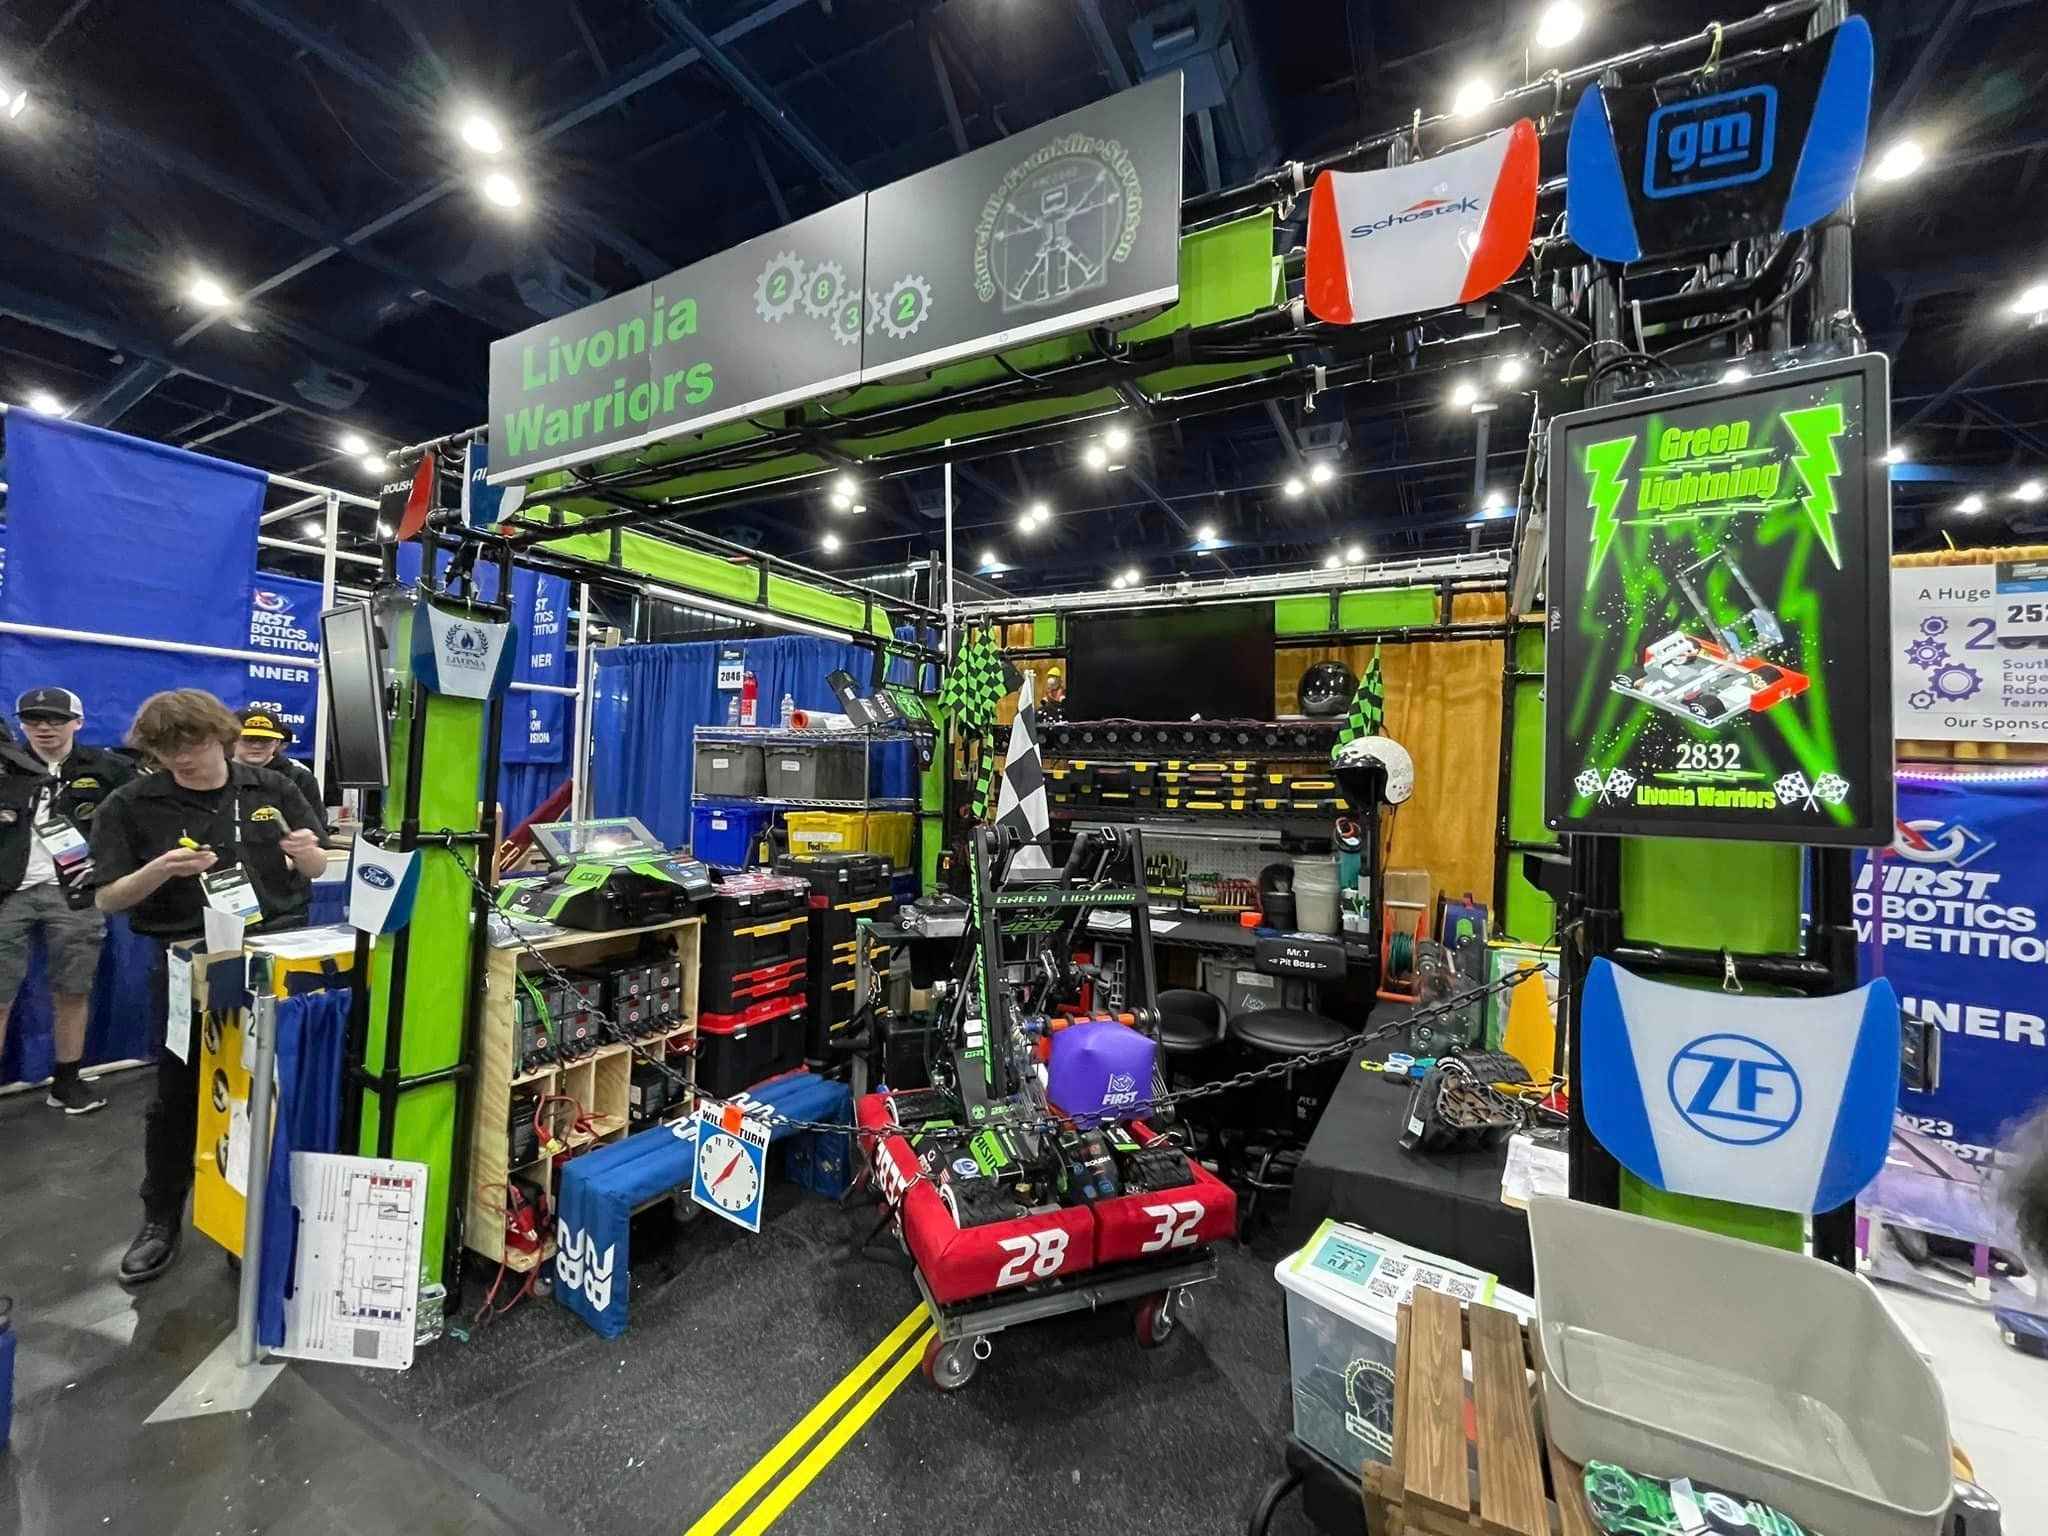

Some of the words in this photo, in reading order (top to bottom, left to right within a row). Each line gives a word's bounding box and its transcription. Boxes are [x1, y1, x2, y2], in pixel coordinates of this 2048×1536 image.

[1667, 112, 1751, 172] gm
[1349, 196, 1480, 239] Schostak
[522, 296, 698, 392] Livonia
[504, 360, 715, 457] Warriors
[1659, 420, 1750, 462] Green
[382, 480, 413, 494] ROUSH
[1637, 461, 1780, 512] Lightning
[1918, 588, 1931, 600] A
[1938, 587, 1991, 602] Huge
[252, 610, 296, 627] IRST
[250, 622, 308, 640] BOTICS
[249, 635, 319, 653] PETITION
[530, 653, 552, 669] NER
[249, 664, 309, 683] NNER
[1944, 716, 1977, 728] Our
[1675, 742, 1741, 770] 2832
[1637, 784, 1694, 807] Livonia
[1697, 786, 1776, 810] Warriors
[364, 867, 389, 886] Ford
[1855, 863, 2001, 900] FIRST
[996, 895, 1048, 904] GREEN
[1061, 893, 1136, 903] LIGHTNING
[1852, 919, 2048, 964] MPETITIO
[1287, 948, 1302, 957] Mr.
[1303, 949, 1310, 957] T
[1293, 959, 1316, 969] Boss
[1103, 1090, 1139, 1106] FIRST
[1680, 1050, 1790, 1129] ZF
[739, 1127, 766, 1148] TURN
[1142, 1200, 1205, 1254] 32
[996, 1228, 1070, 1288] 28
